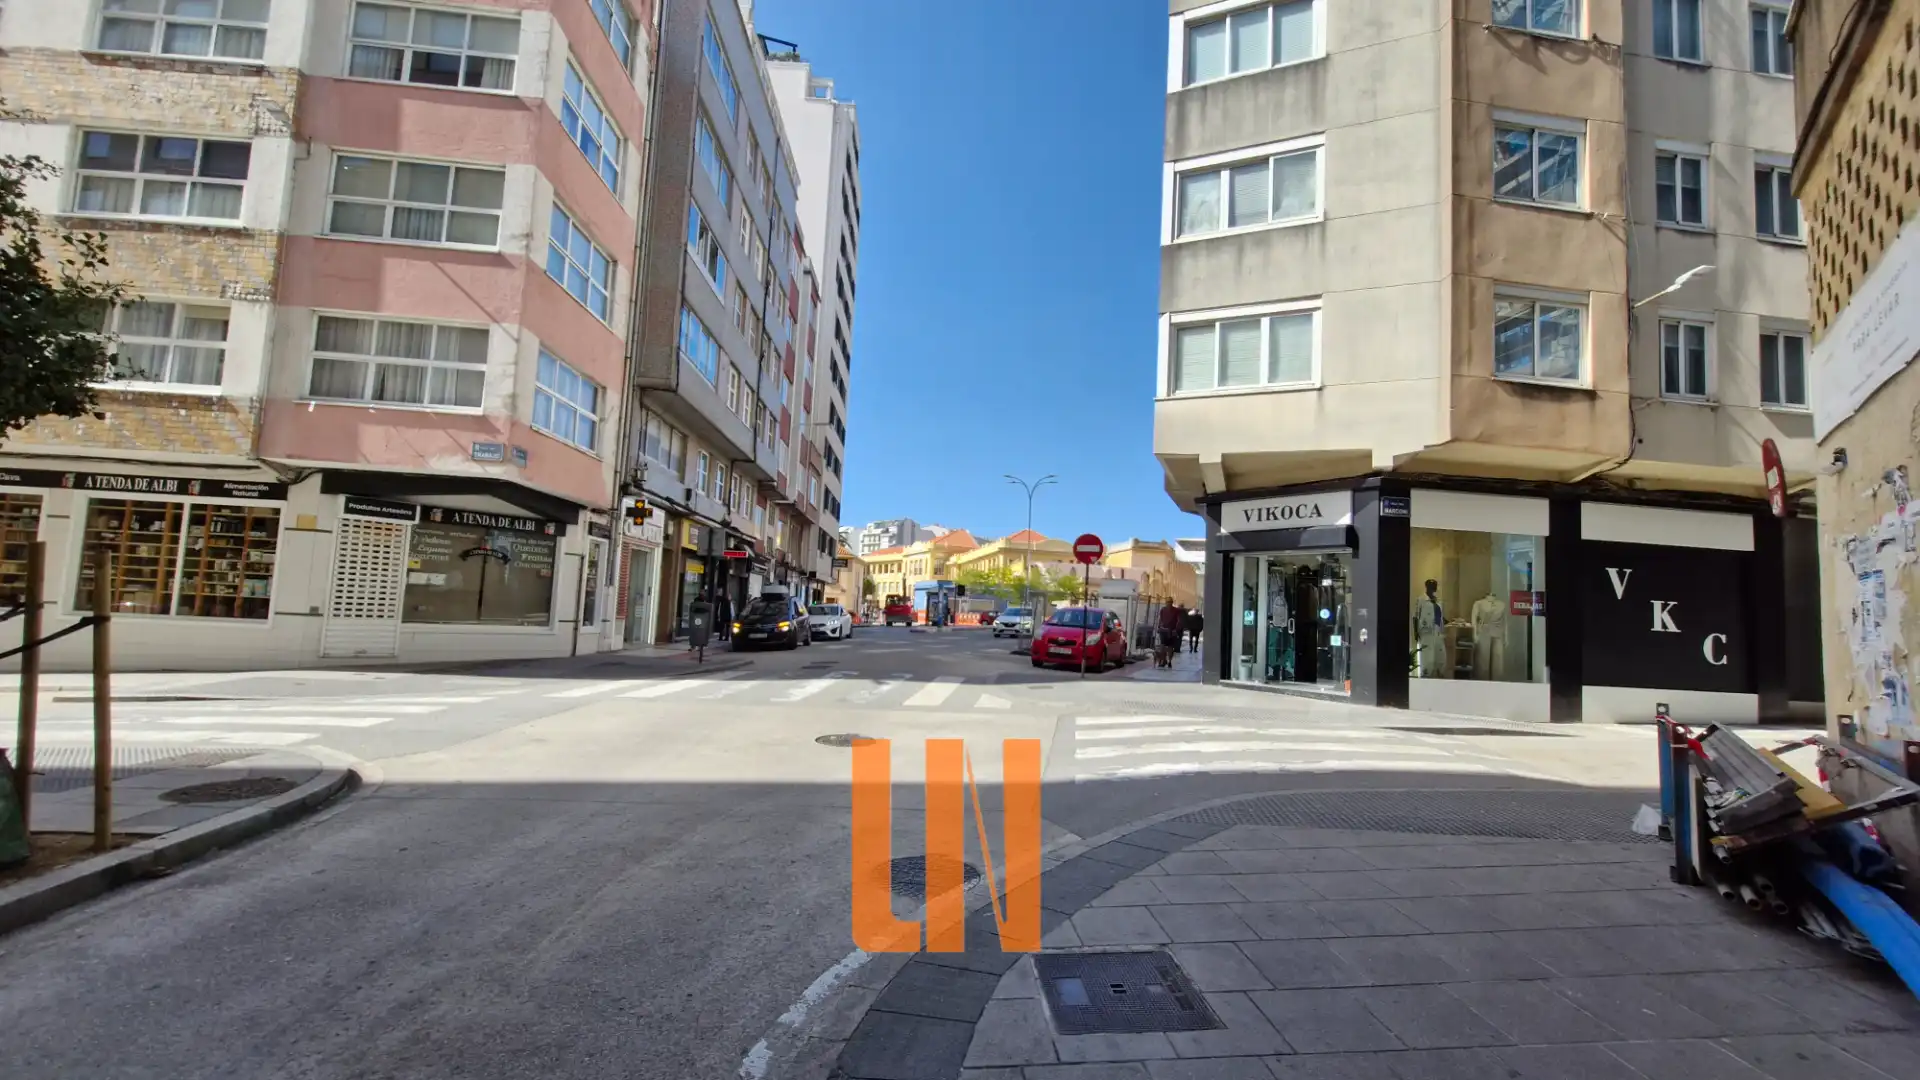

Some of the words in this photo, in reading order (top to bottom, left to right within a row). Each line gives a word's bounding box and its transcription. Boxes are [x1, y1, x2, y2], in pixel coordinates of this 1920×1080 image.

[85, 475, 93, 488] A
[95, 475, 132, 490] TENDA
[134, 477, 149, 491] DE
[151, 478, 178, 492] ALBI
[452, 512, 460, 523] A
[462, 512, 496, 527] TENDA
[498, 518, 511, 529] DE
[513, 519, 536, 531] ALBI
[1242, 503, 1323, 523] VIKOCA
[1605, 567, 1632, 600] V
[1650, 600, 1681, 633] K
[1703, 633, 1728, 665] C
